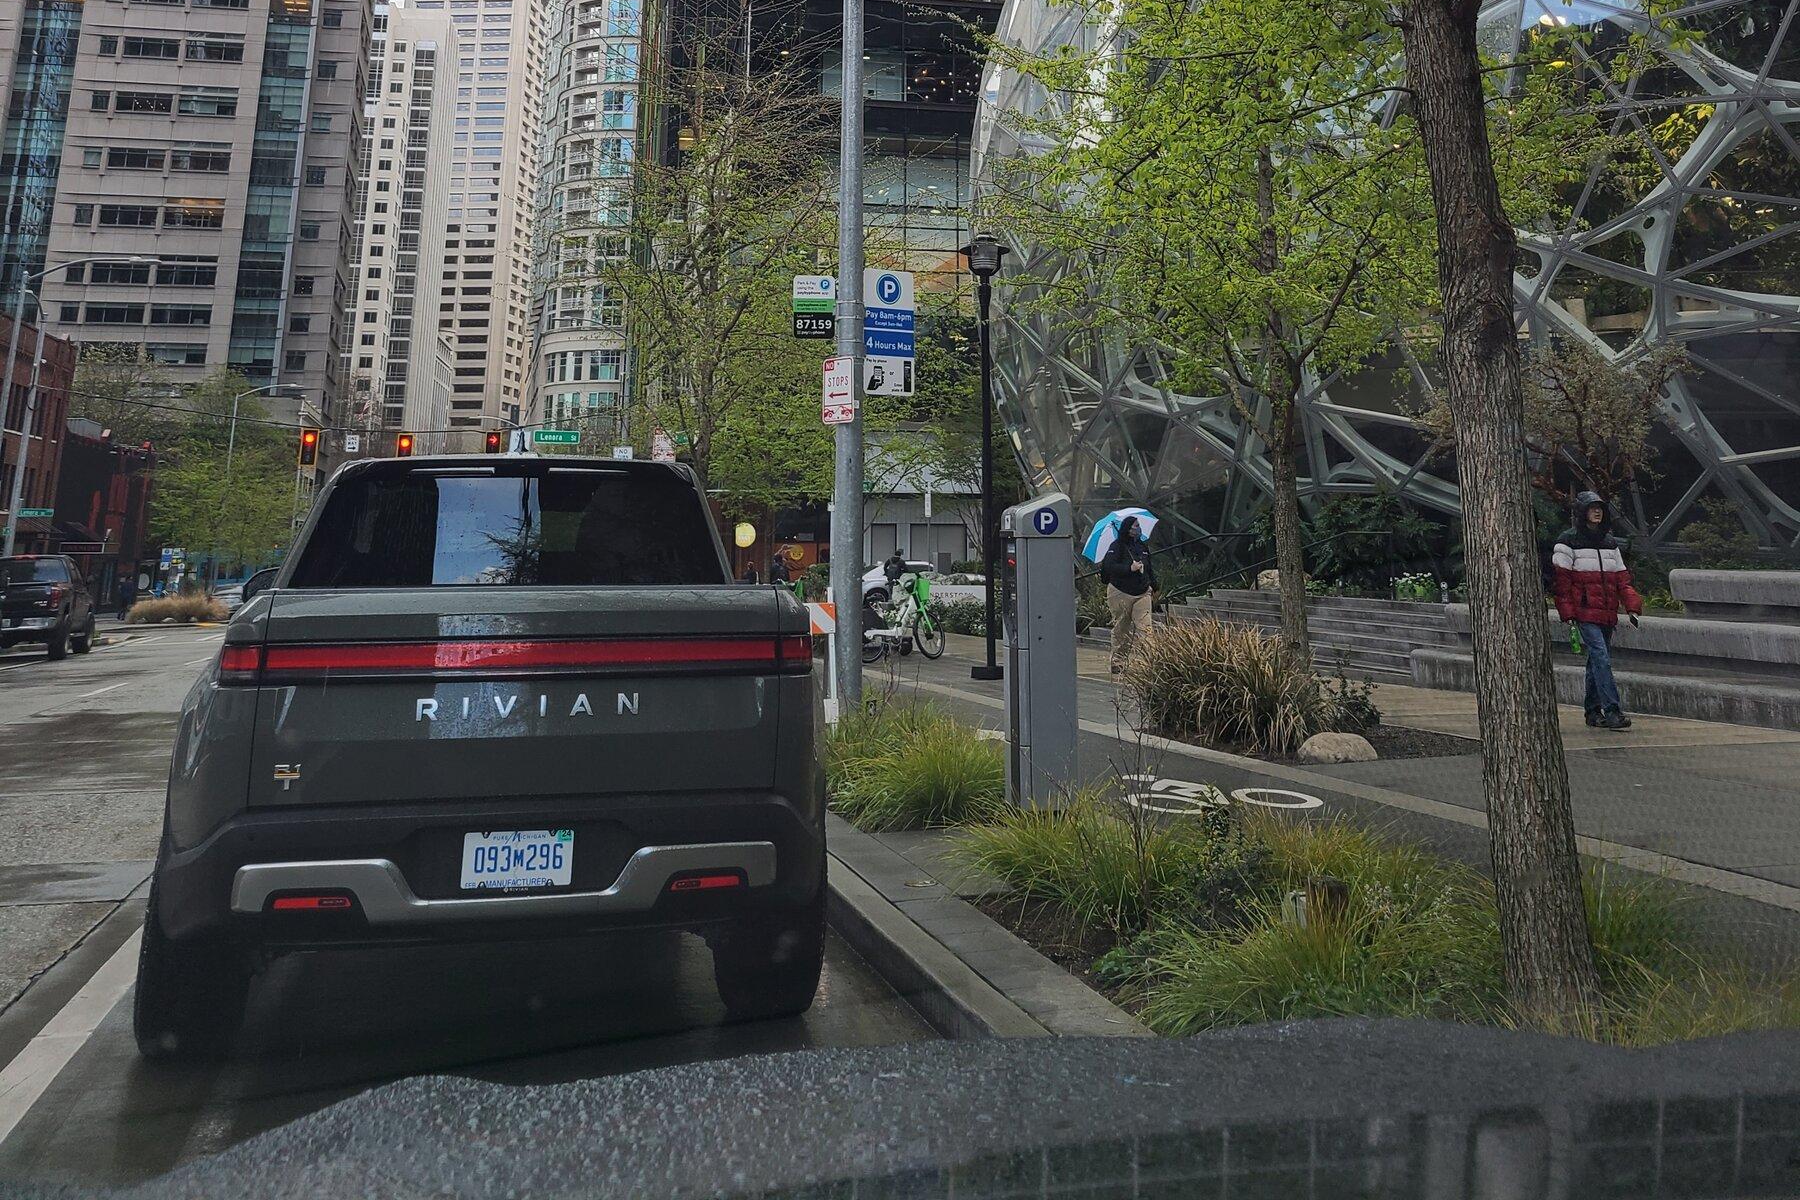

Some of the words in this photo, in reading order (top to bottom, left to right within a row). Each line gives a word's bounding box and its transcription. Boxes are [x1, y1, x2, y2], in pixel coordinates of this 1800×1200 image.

[865, 310, 878, 320] Pay
[879, 310, 912, 322] 8am-6pm
[796, 319, 832, 329] 87159
[866, 336, 873, 348] 4
[874, 340, 896, 350] Hours
[897, 342, 912, 351] Max
[825, 362, 834, 370] NO
[828, 376, 848, 387] STOPS
[540, 433, 562, 441] Lenora
[1040, 512, 1054, 531] P
[415, 692, 639, 722] RIVIAN
[474, 843, 563, 874] 093M296
[486, 878, 547, 888] MANUFACTURER
